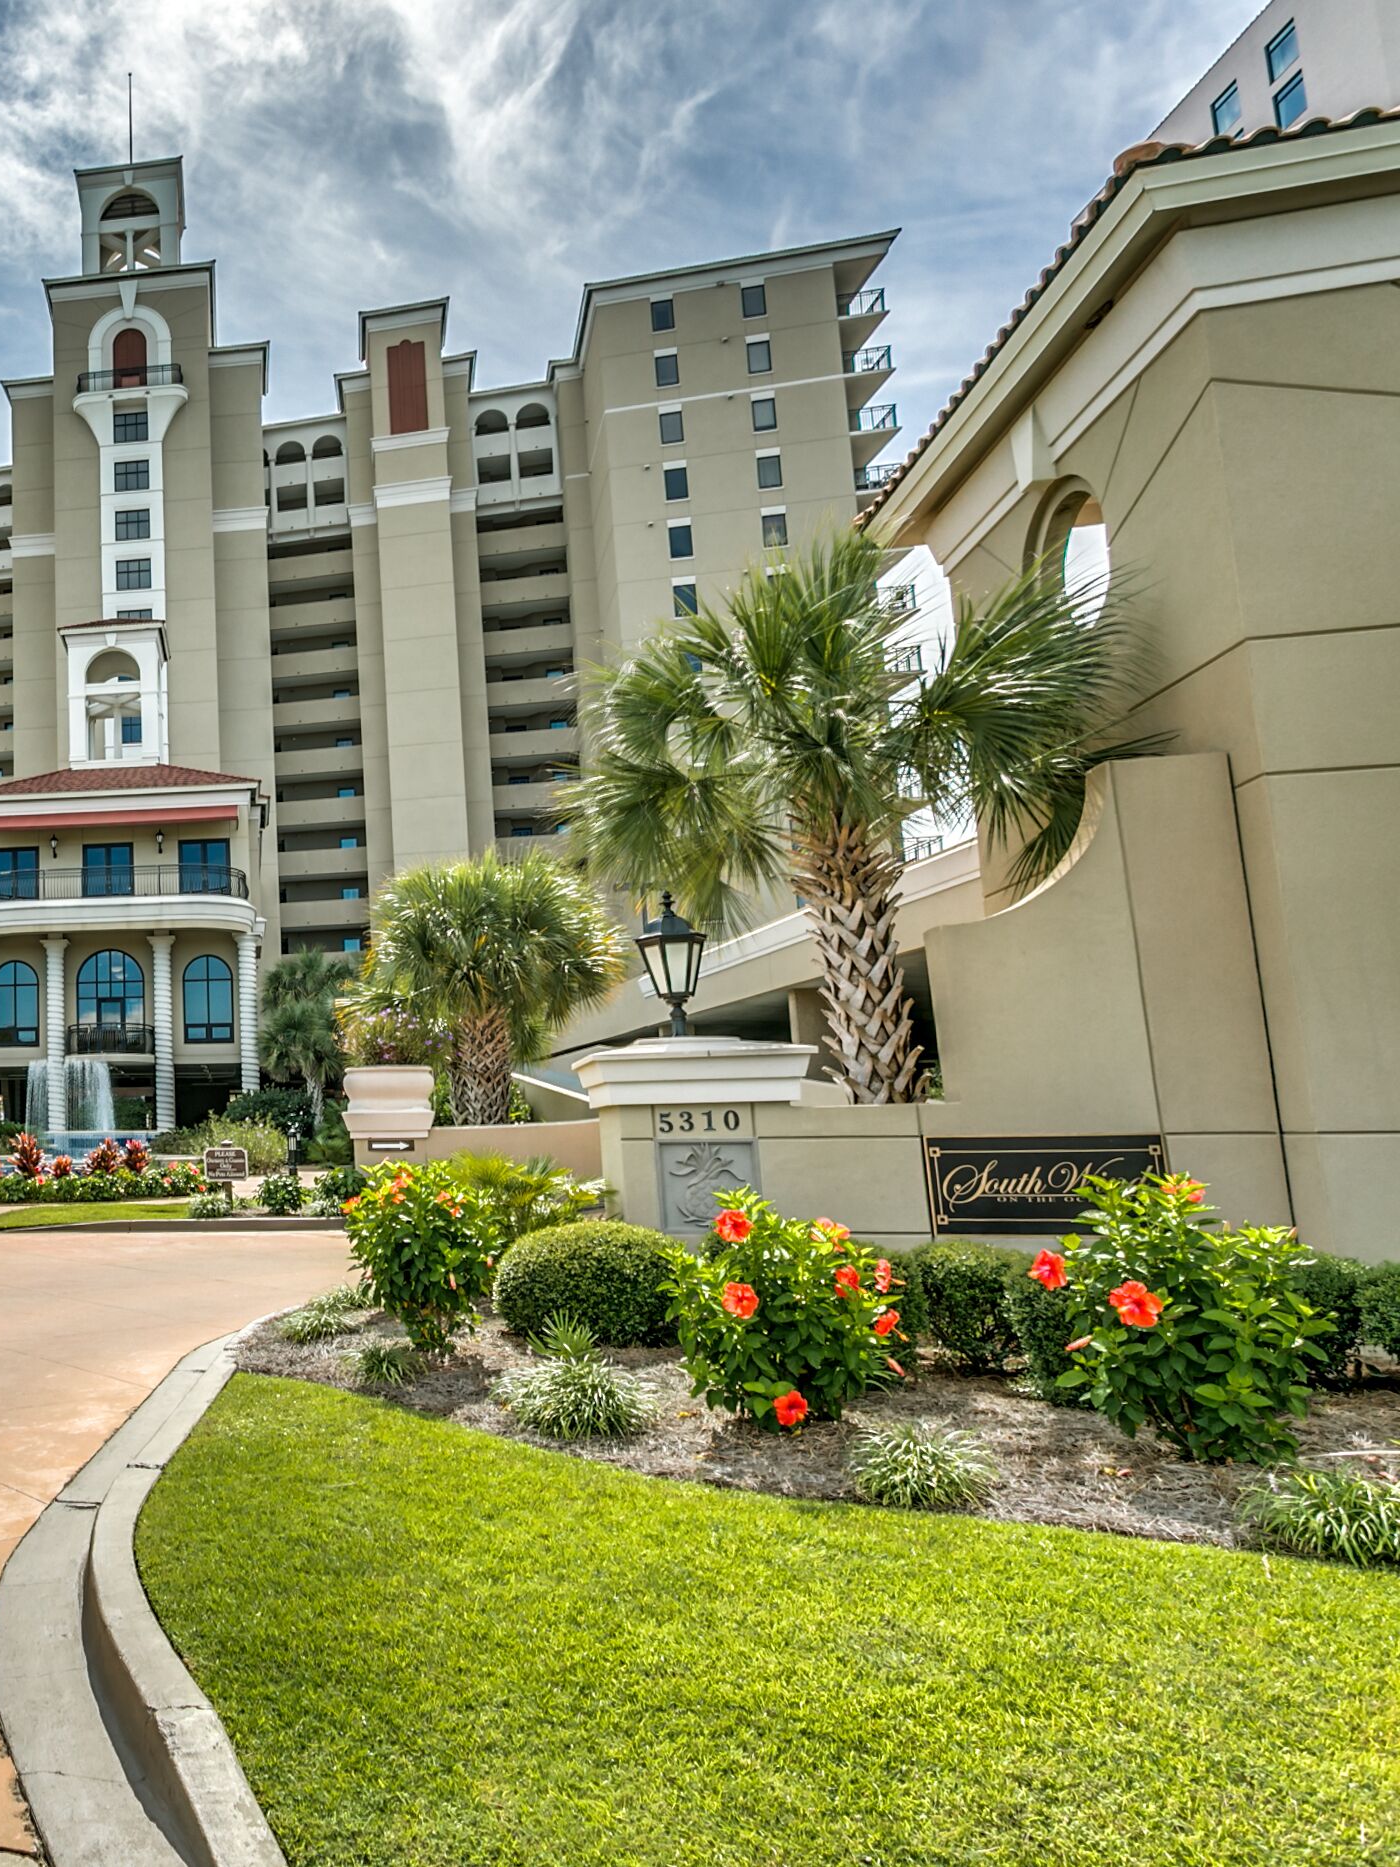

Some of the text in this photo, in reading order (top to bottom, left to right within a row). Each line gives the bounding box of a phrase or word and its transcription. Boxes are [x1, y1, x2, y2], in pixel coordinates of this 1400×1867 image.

[659, 1109, 740, 1133] 5310
[942, 1157, 1153, 1213] South Wid
